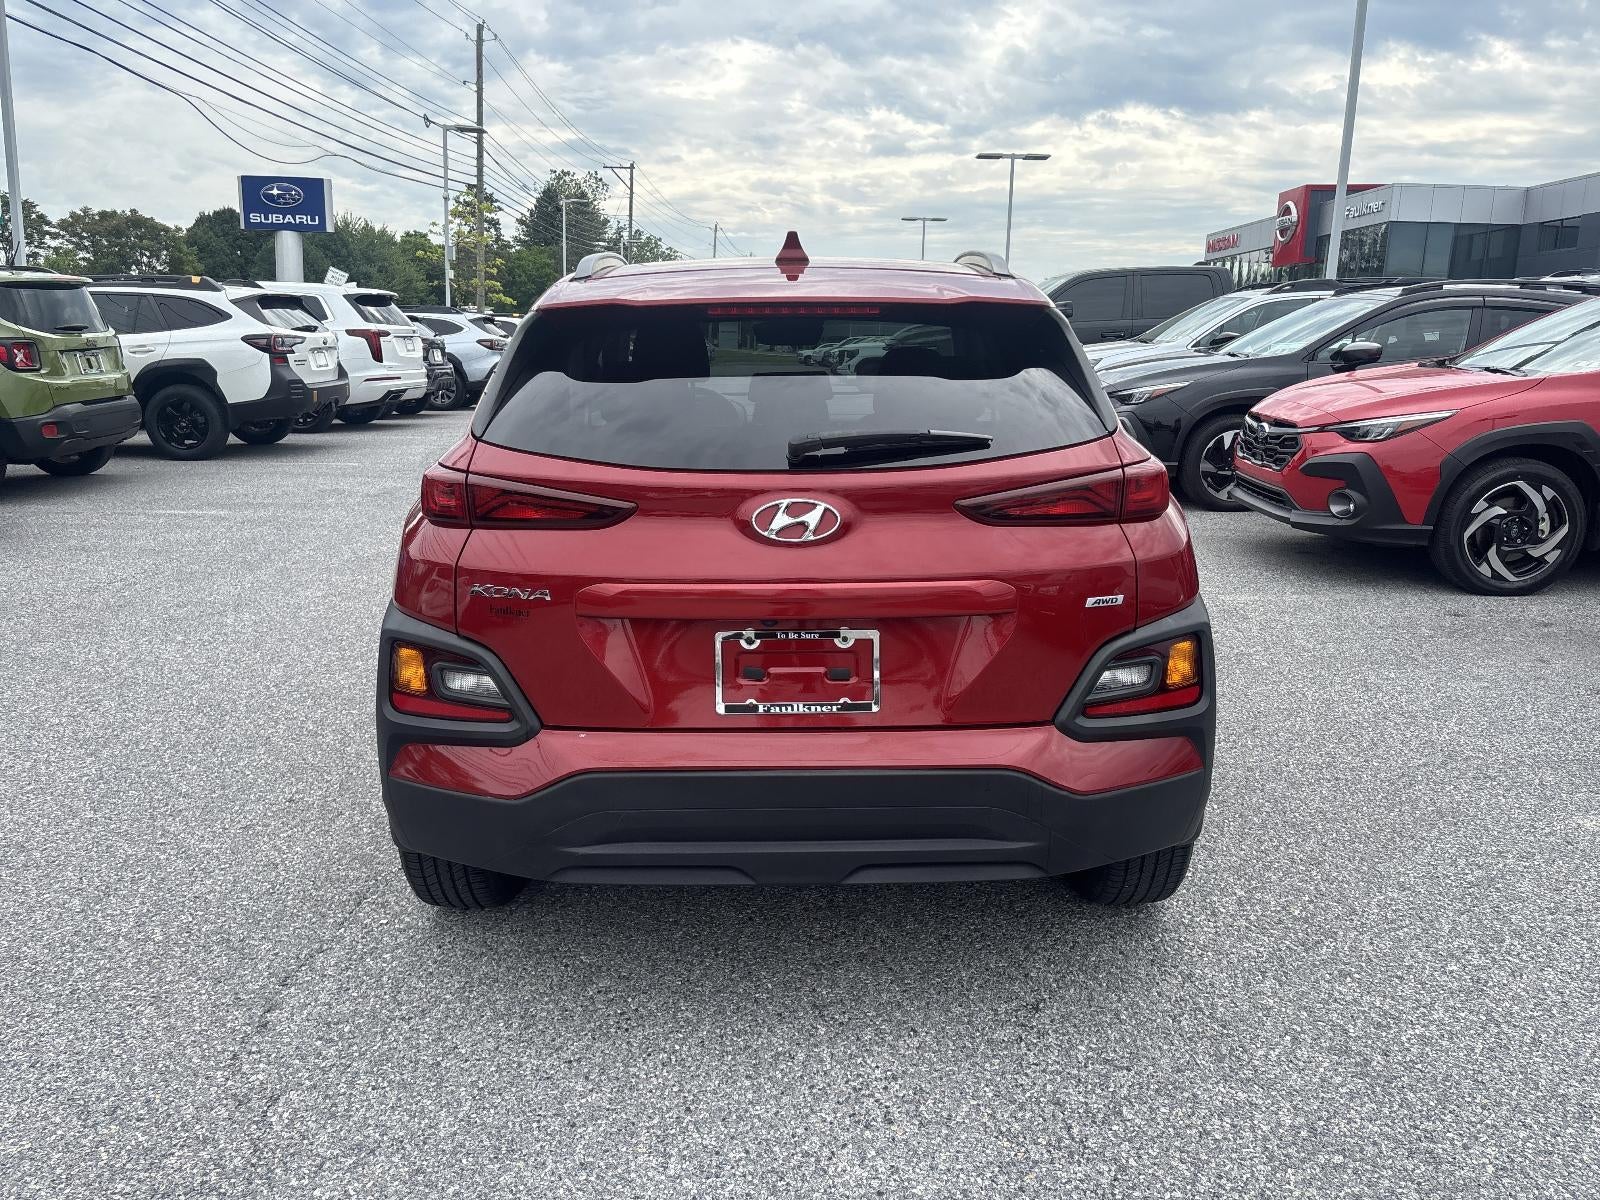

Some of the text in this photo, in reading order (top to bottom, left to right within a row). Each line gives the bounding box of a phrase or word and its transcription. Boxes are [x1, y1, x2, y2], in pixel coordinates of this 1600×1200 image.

[1345, 200, 1384, 218] Faulkner
[249, 213, 319, 225] SUBARU
[1207, 233, 1240, 254] NISSAN
[469, 583, 551, 601] KONA
[1091, 597, 1119, 606] AWD
[758, 703, 842, 713] Faulkner
